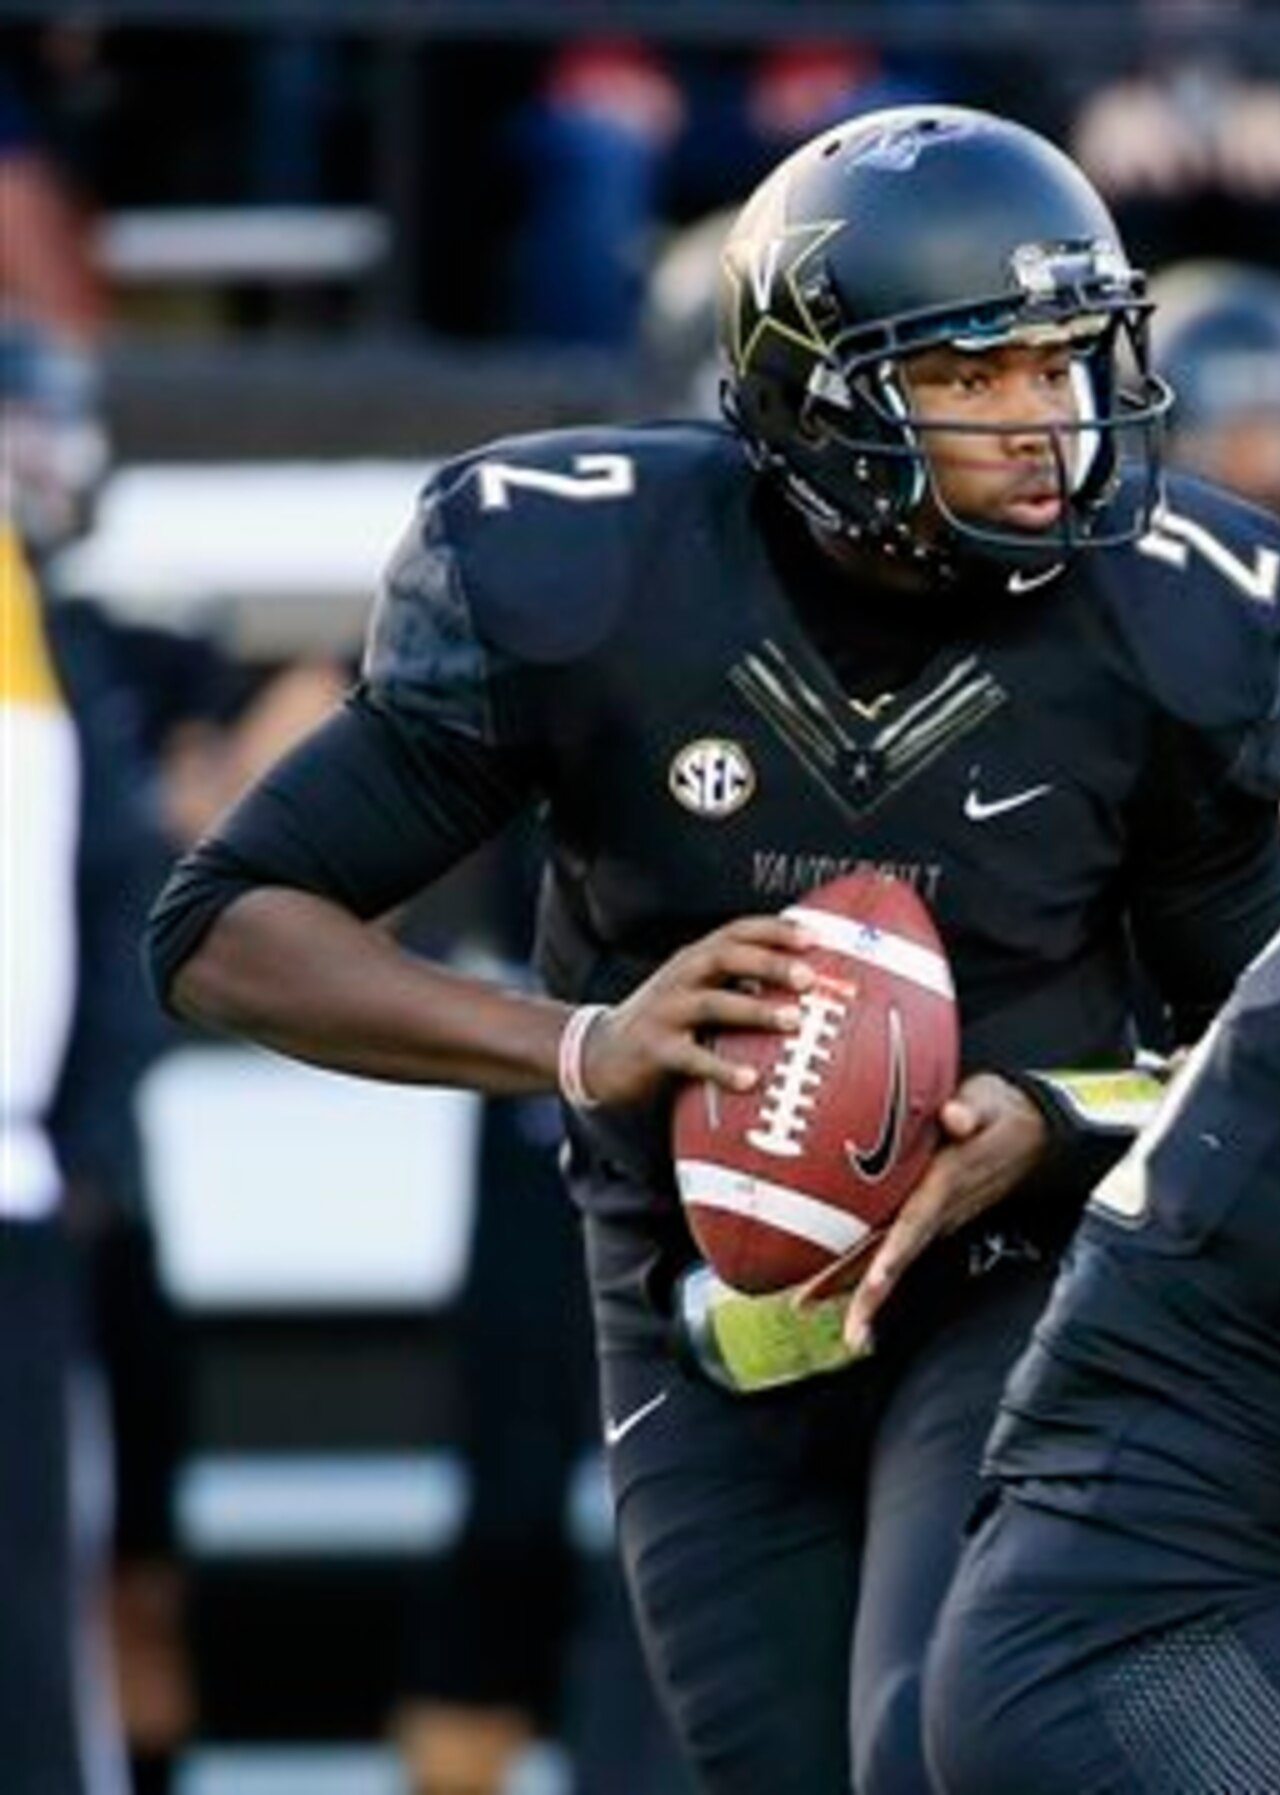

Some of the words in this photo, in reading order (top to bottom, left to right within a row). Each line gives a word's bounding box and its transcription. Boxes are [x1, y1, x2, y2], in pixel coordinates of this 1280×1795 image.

[748, 238, 784, 311] V
[479, 454, 634, 511] 2
[671, 740, 753, 817] SEC
[752, 850, 942, 900] VANDBILT
